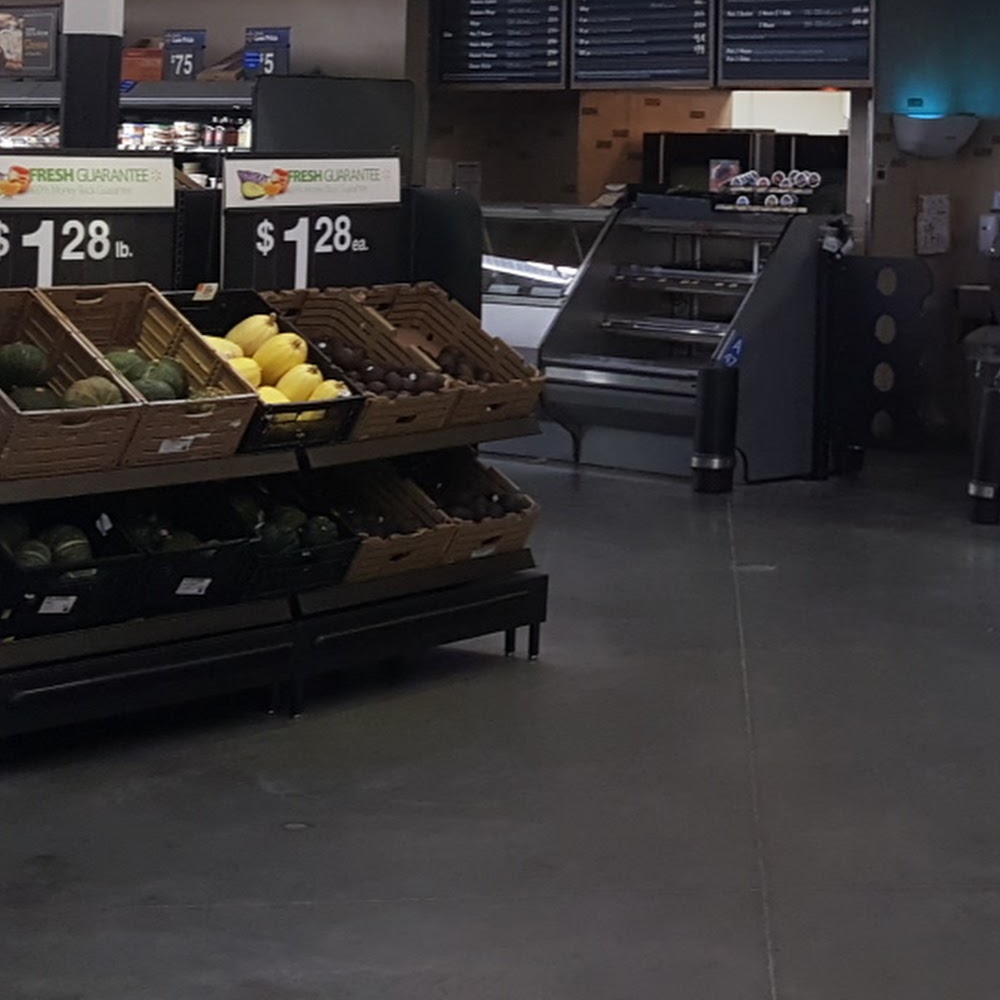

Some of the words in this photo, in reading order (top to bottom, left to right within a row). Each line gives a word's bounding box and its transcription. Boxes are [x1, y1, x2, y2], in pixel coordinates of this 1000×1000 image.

[31, 168, 74, 182] FRESH
[76, 168, 149, 182] GUARANTEE
[289, 169, 322, 182] FRESH
[324, 168, 381, 181] GUARANTEE
[115, 241, 133, 258] lb.
